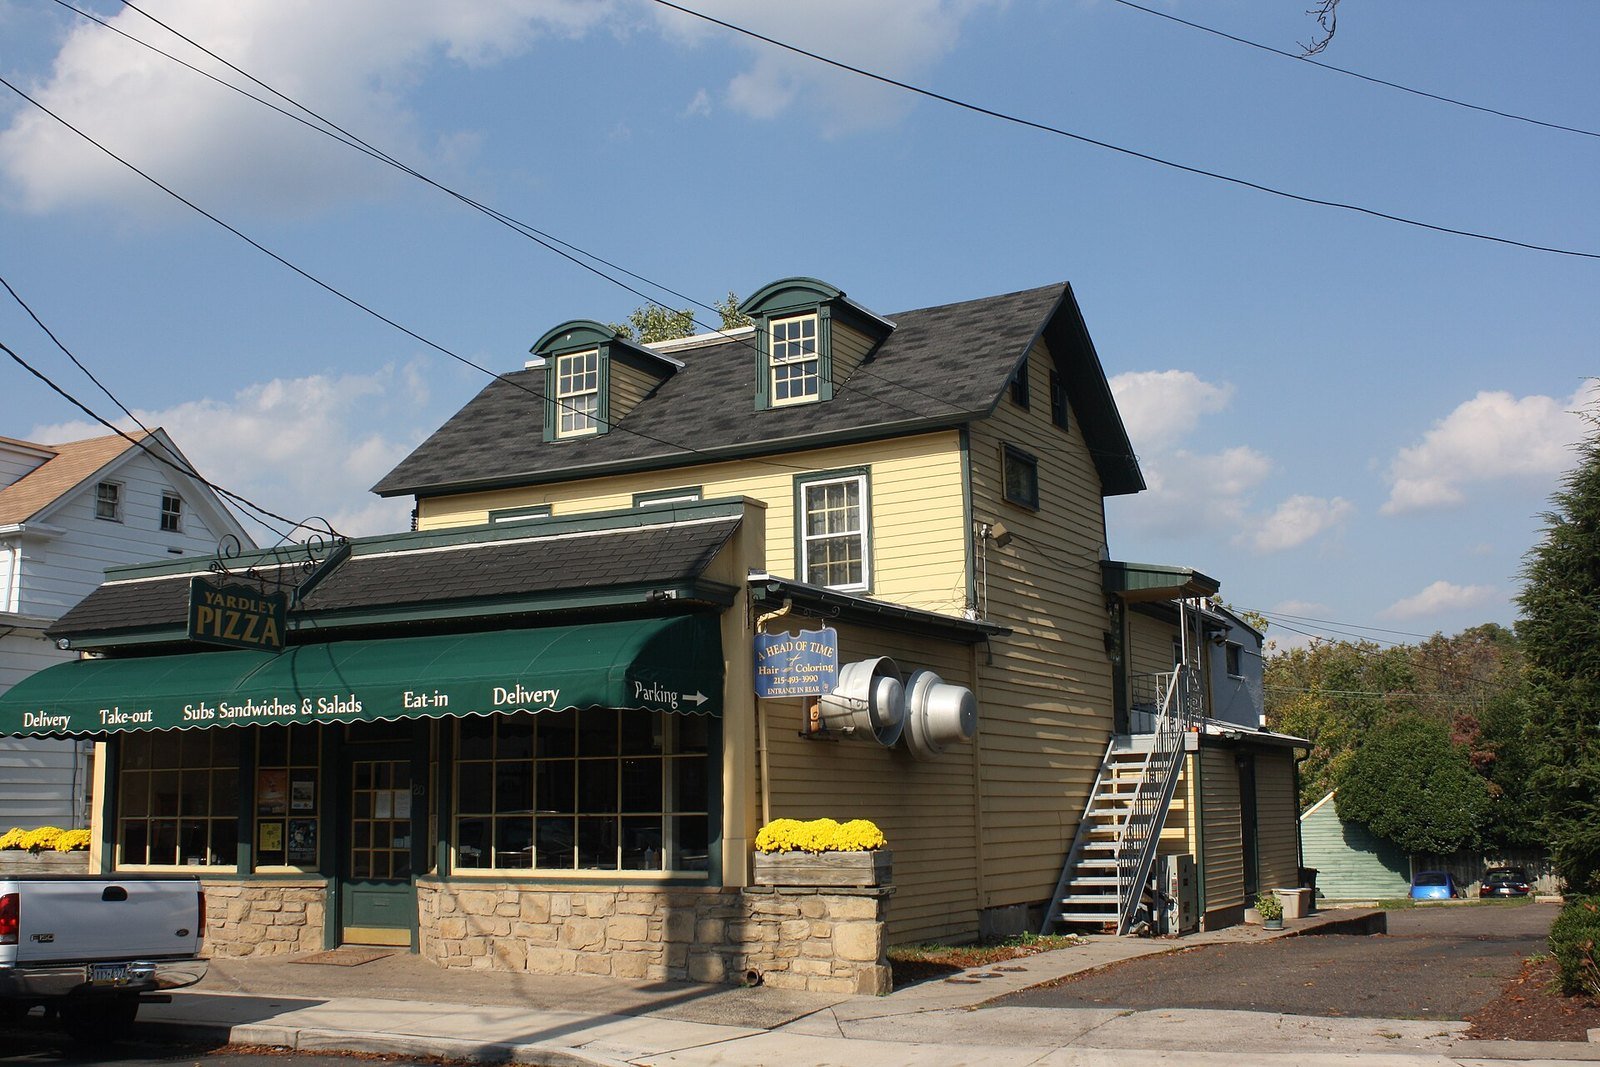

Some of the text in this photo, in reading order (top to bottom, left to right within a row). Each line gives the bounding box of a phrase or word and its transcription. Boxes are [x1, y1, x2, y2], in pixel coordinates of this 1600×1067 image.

[204, 591, 278, 615] YARDLEY
[196, 606, 281, 647] PIZZA
[758, 641, 834, 661] A HEAD OF TIME
[758, 663, 834, 675] Hair Coloring
[773, 675, 818, 684] 215-493-3990
[403, 690, 449, 709] Eat-in
[493, 684, 560, 707] Delivery
[634, 681, 678, 709] Parking
[99, 706, 153, 725] Take-out
[183, 694, 362, 721] Subs Sandwiches & Salads
[24, 711, 71, 730] Delivery
